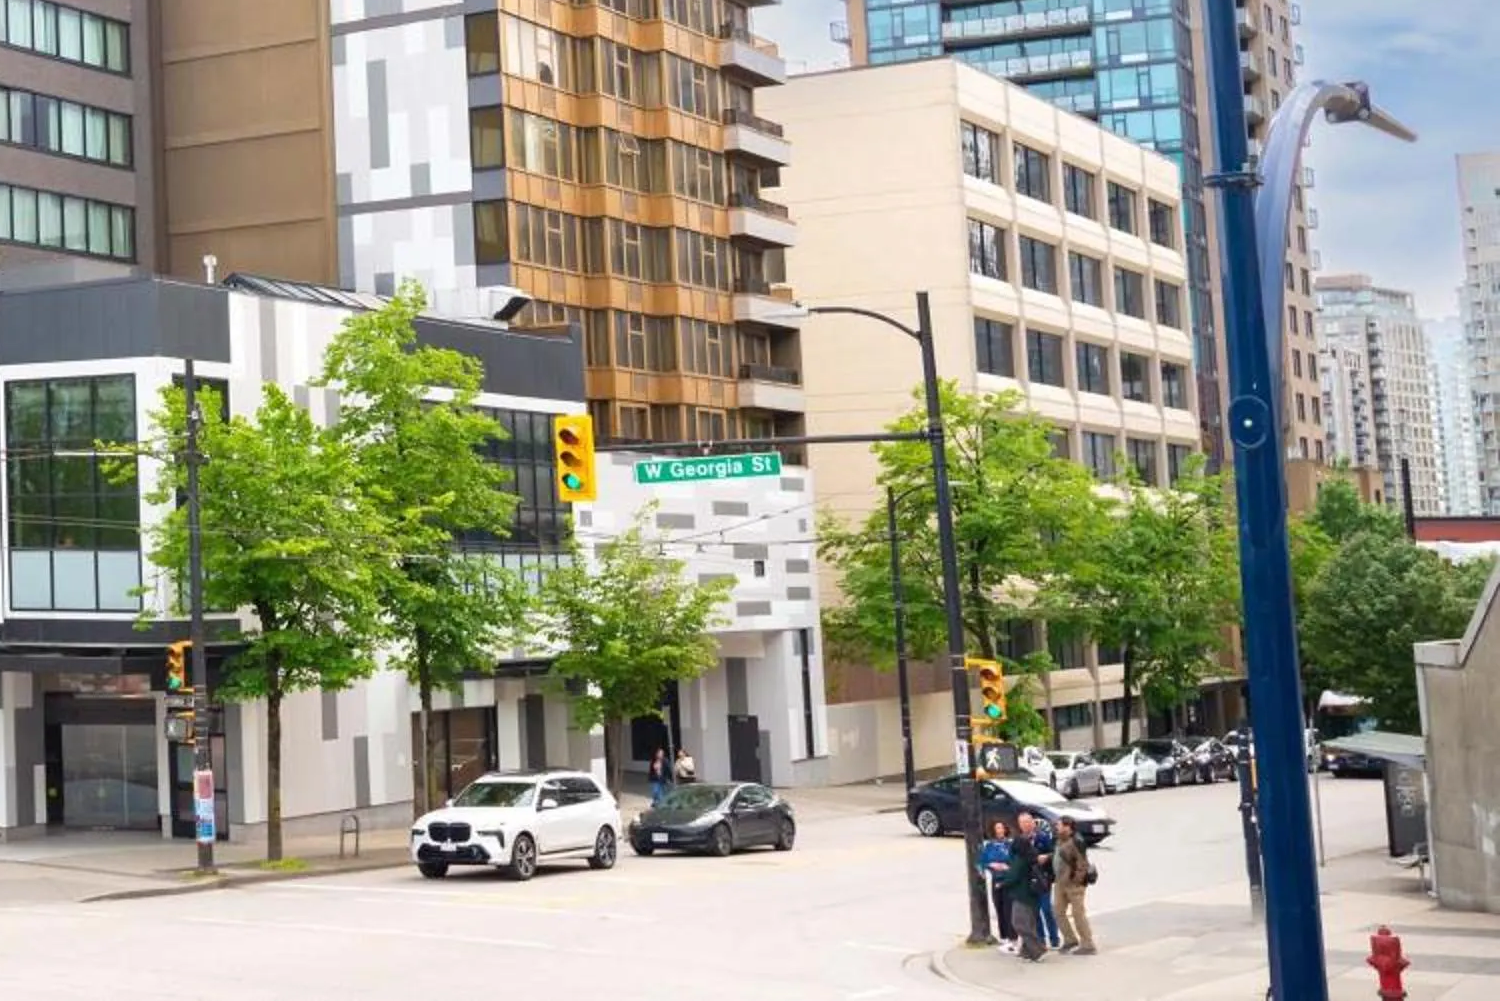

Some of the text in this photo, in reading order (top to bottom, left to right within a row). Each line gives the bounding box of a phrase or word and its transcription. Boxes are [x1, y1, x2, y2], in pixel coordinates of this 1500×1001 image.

[644, 456, 772, 478] W Georgia St
